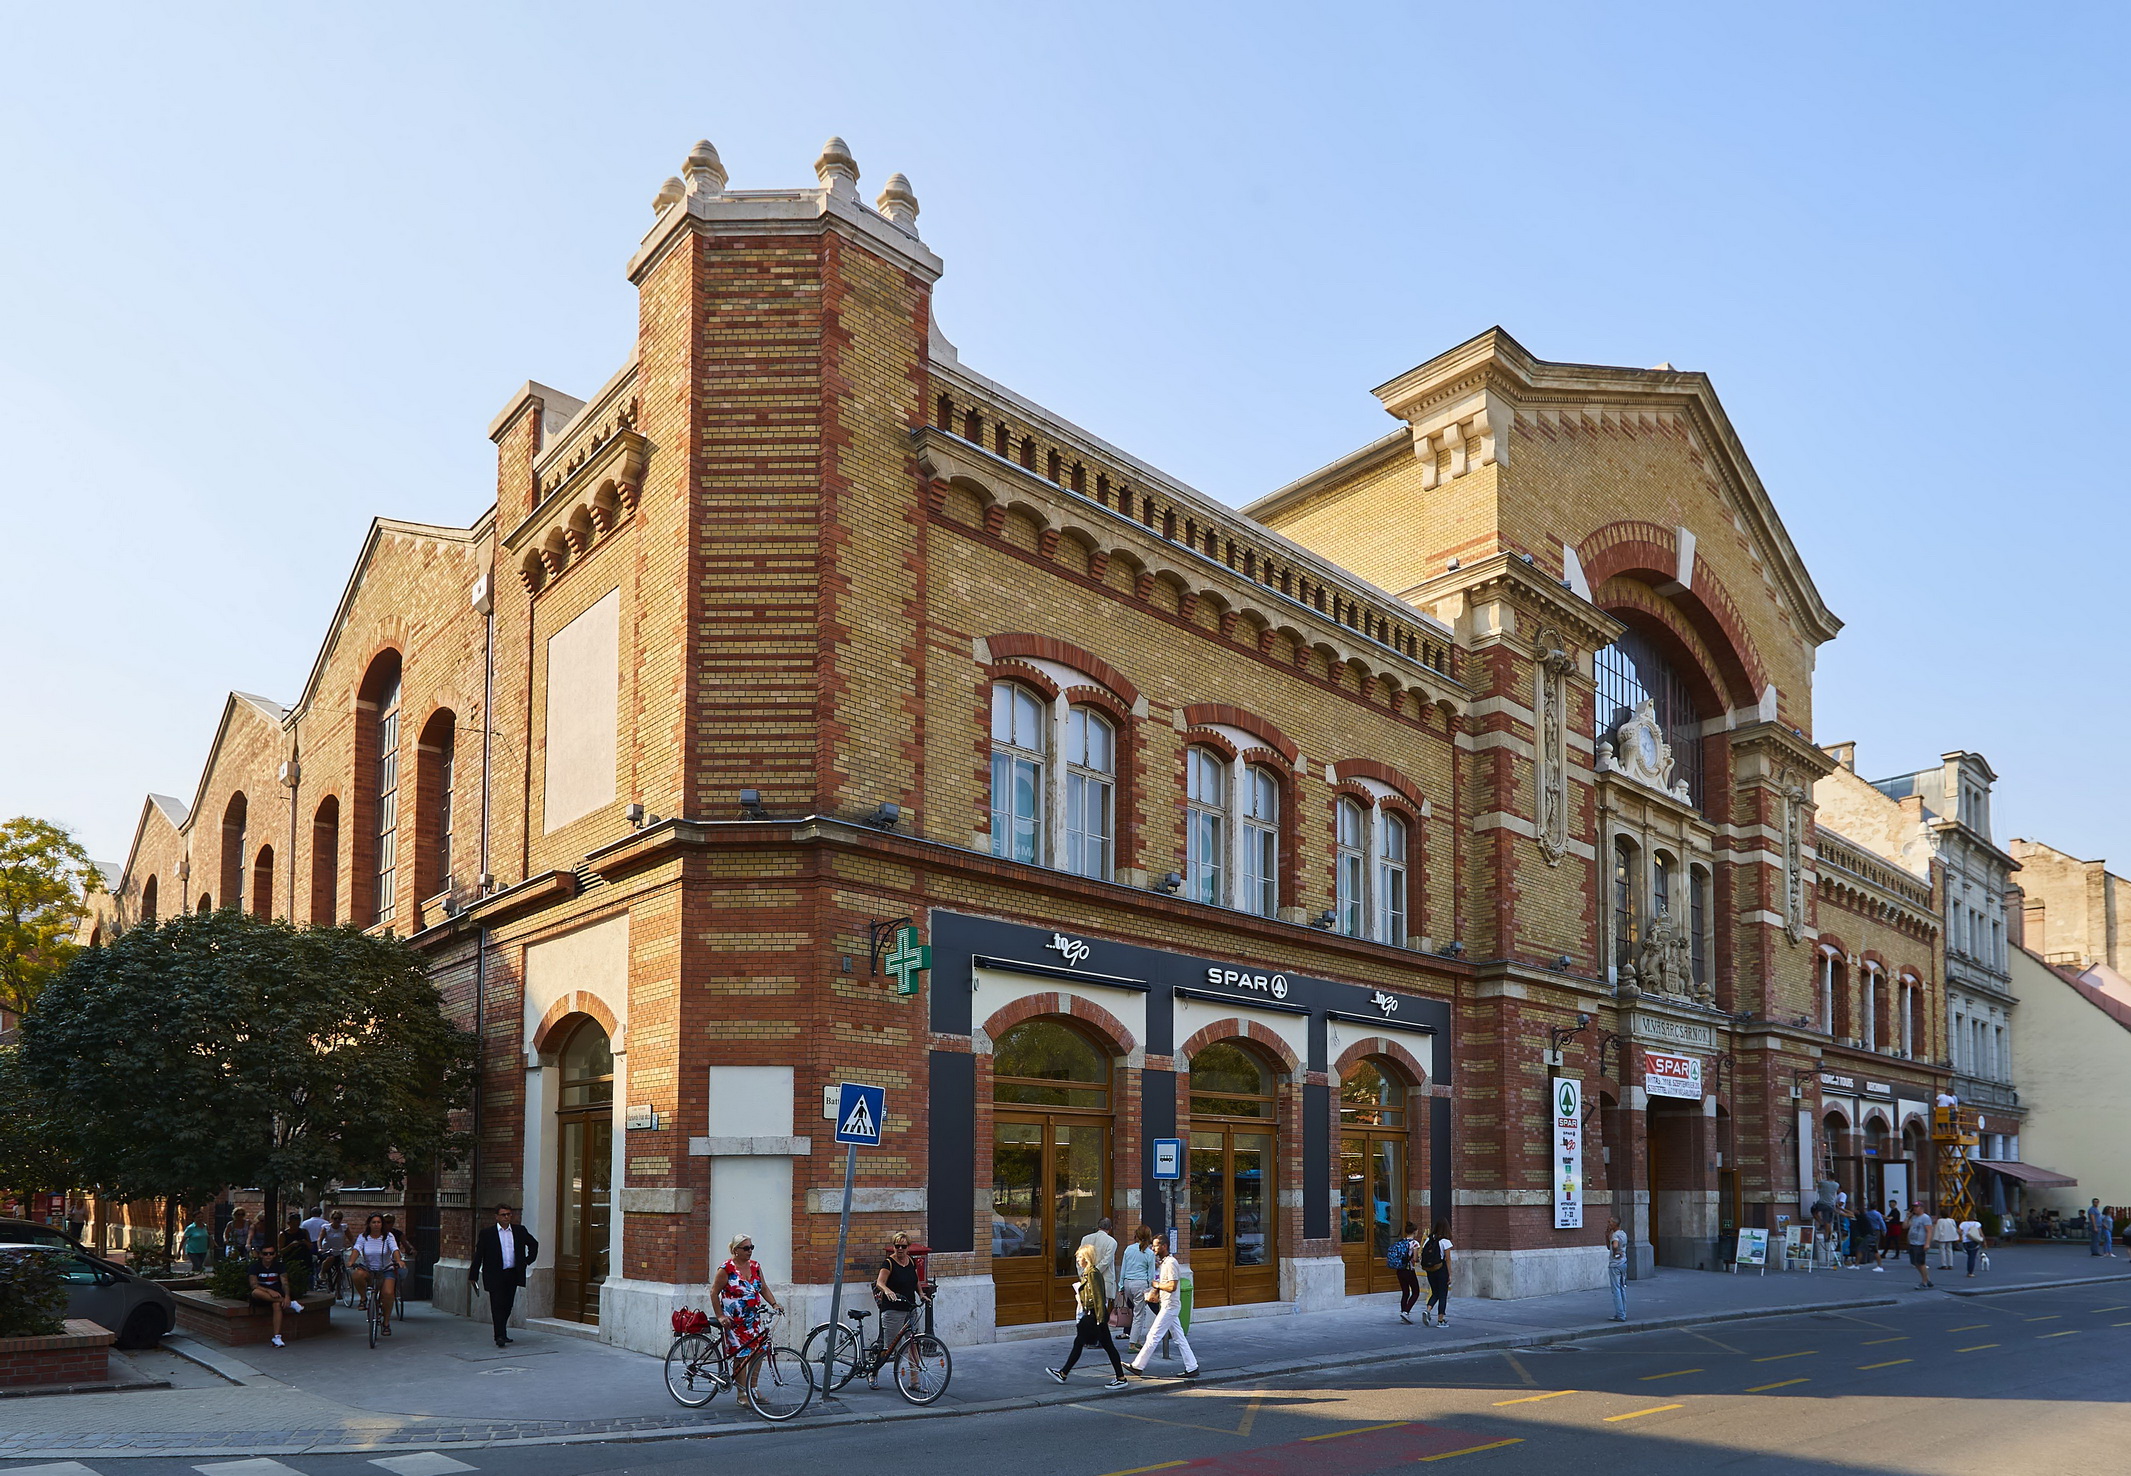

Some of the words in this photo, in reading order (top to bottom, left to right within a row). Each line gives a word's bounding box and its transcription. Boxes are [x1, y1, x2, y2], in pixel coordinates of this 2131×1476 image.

[1207, 967, 1268, 992] SPAR
[1655, 1058, 1689, 1076] SPAR
[1558, 1118, 1577, 1127] SPAR
